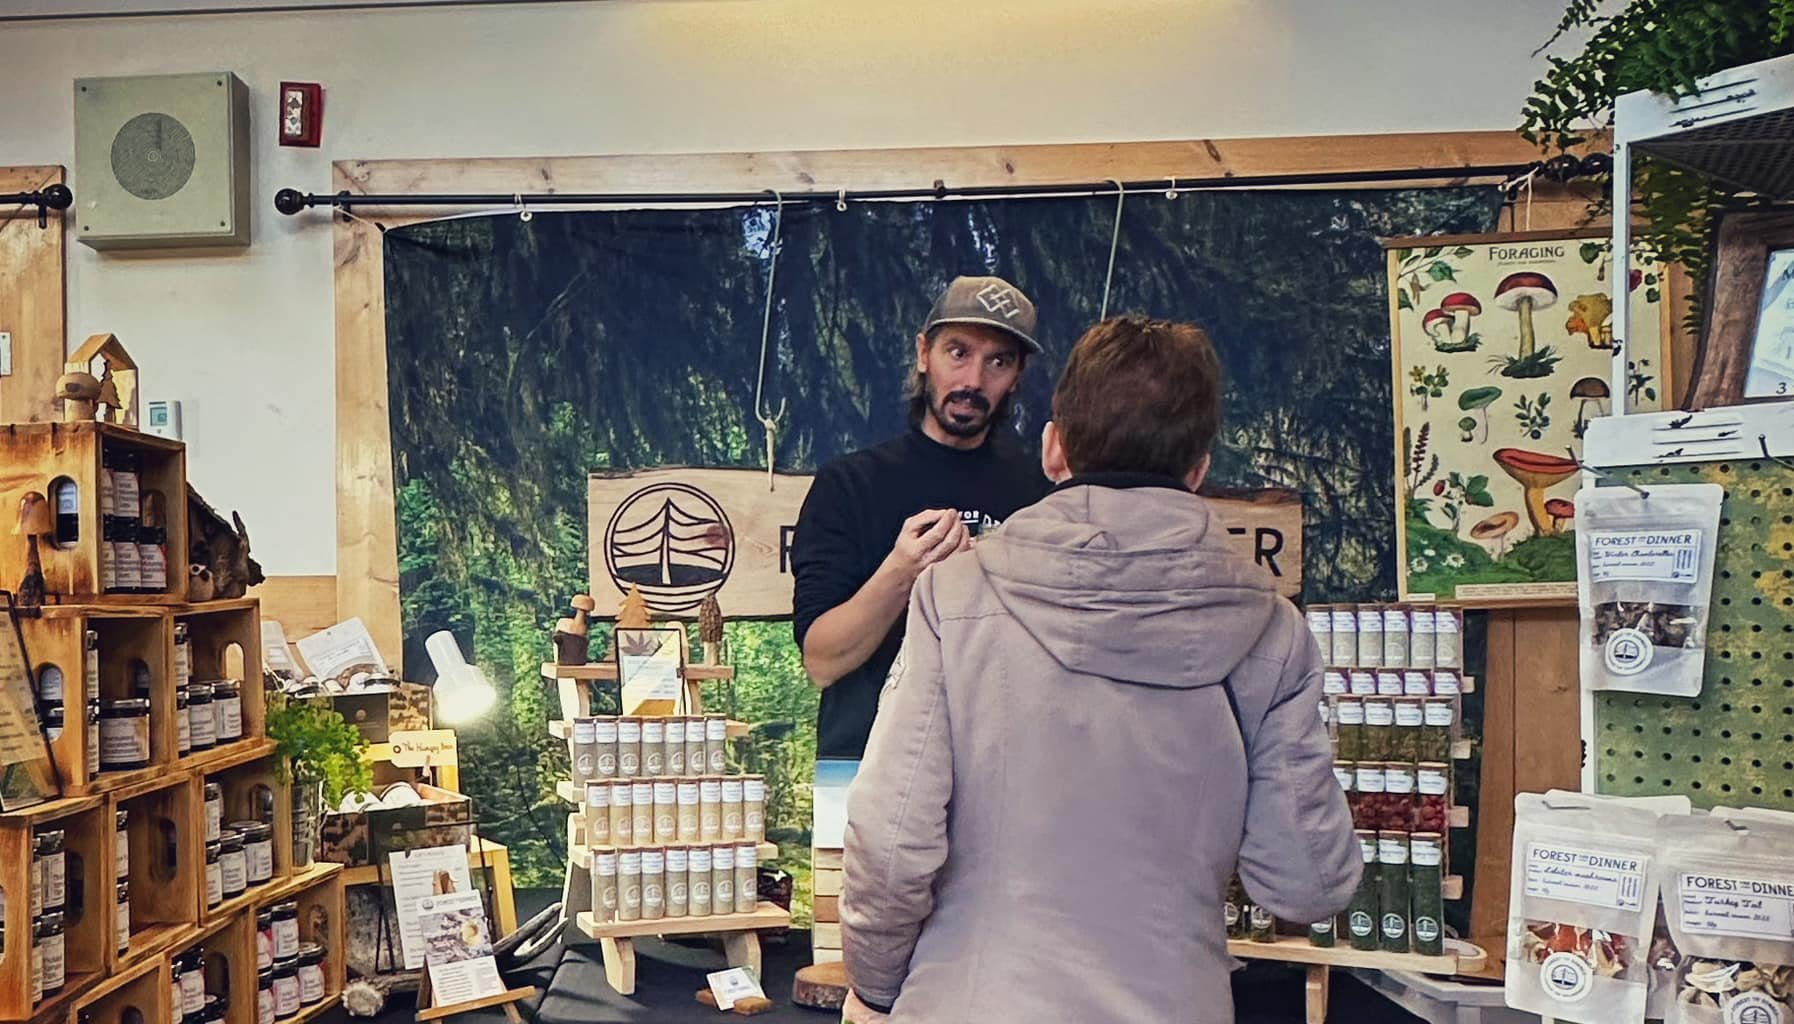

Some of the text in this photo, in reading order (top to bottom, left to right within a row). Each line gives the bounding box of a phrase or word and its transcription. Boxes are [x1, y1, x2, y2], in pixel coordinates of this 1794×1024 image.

[1595, 536, 1637, 546] FOREST
[1646, 534, 1692, 545] DINNER
[1533, 848, 1577, 863] FOREST
[1588, 855, 1638, 872] DINNER
[1686, 876, 1738, 892] FOREST
[1752, 881, 1794, 898] DINNE
